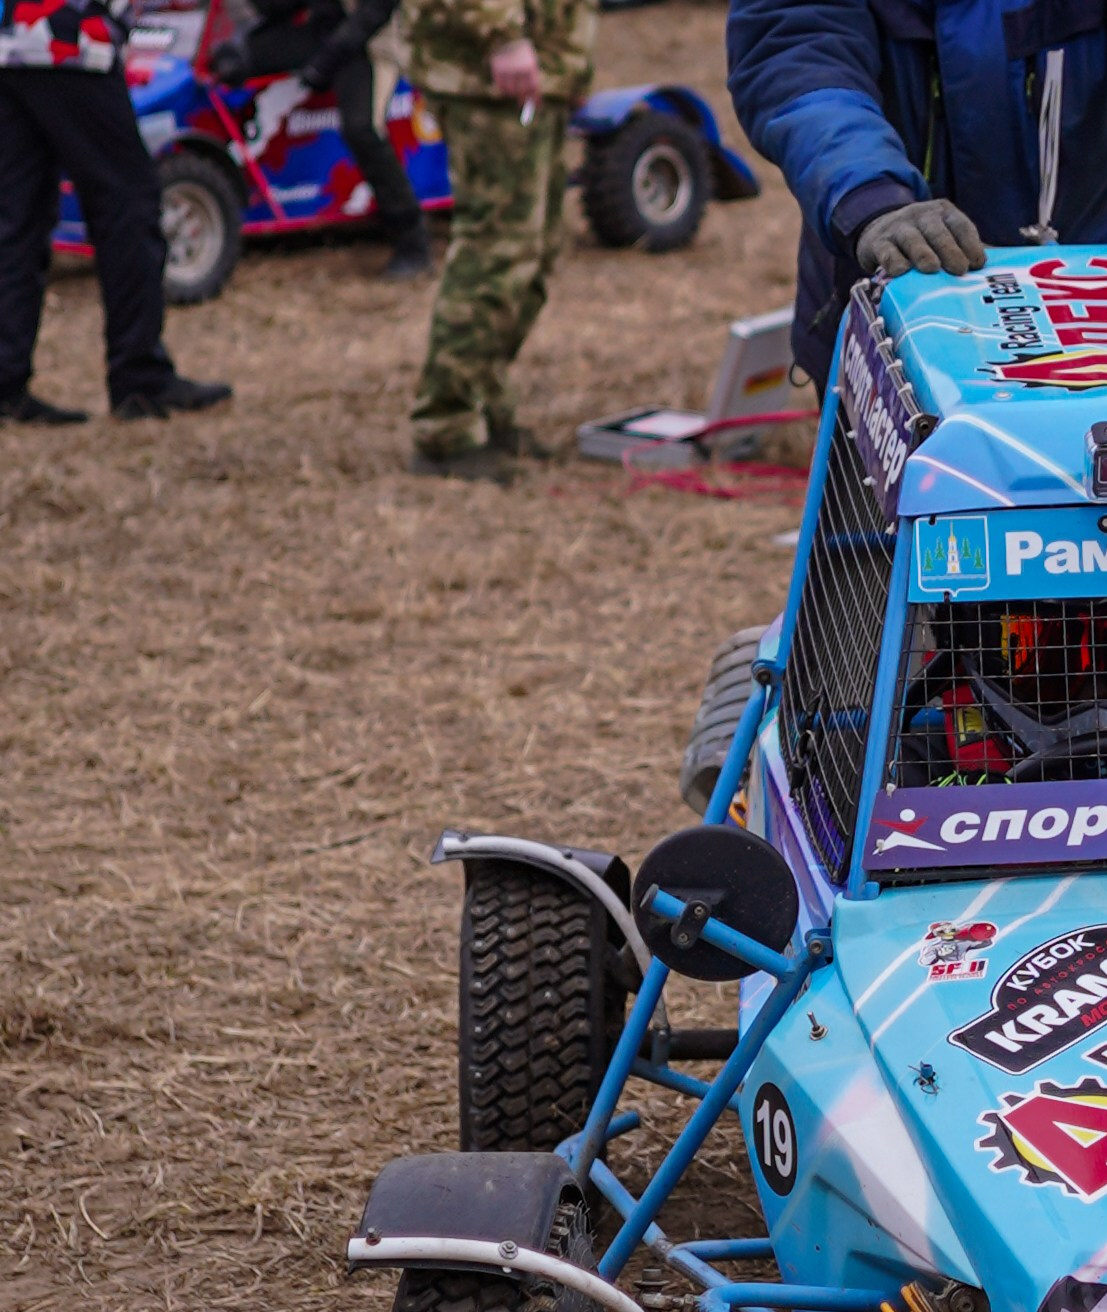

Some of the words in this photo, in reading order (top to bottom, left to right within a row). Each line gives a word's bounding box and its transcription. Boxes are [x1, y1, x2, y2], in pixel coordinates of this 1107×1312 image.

[982, 273, 1025, 304] Team
[999, 305, 1044, 349] Racing
[931, 962, 961, 976] SF
[1006, 933, 1095, 991] КУБОК
[1007, 997, 1028, 1011] ПО
[756, 1098, 793, 1178] 19
